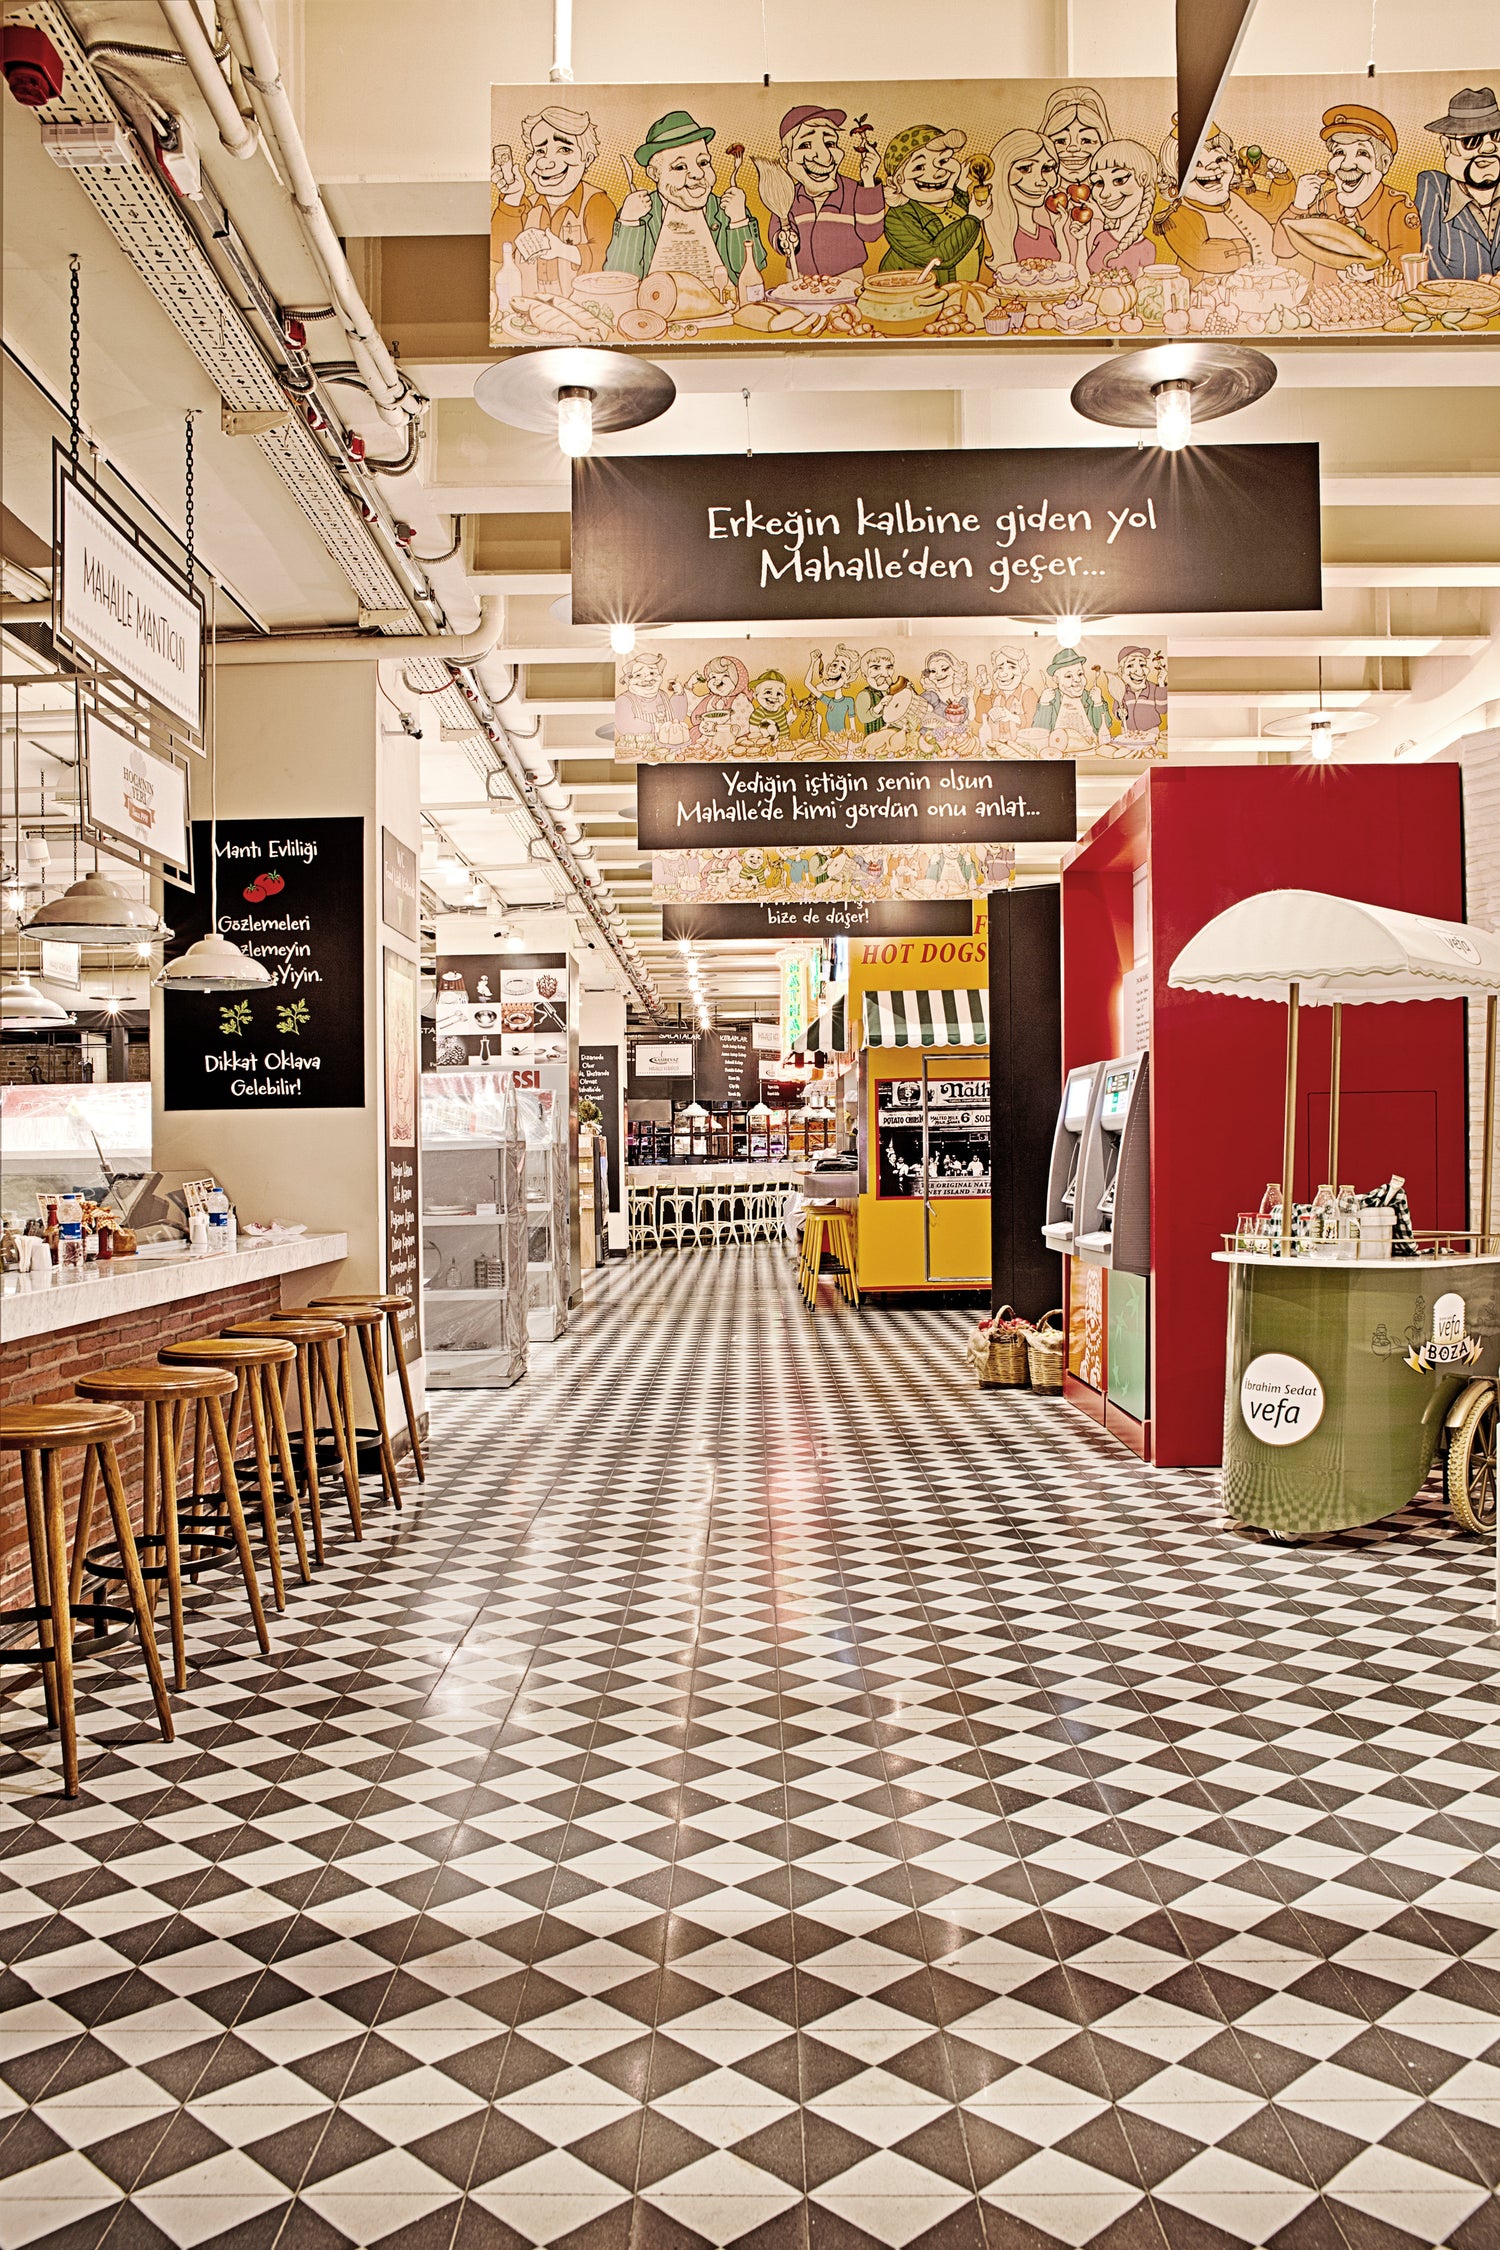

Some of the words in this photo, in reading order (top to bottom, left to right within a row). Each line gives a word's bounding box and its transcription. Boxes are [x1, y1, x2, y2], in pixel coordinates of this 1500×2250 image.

[708, 499, 840, 551] Erkeğin
[857, 497, 980, 535] kalbine
[995, 498, 1092, 547] giden
[1106, 497, 1157, 544] yol
[760, 545, 973, 588] Mahalle'den
[988, 553, 1106, 593] geçer...
[83, 546, 134, 628] MAHALLE
[722, 770, 797, 802] Yediğin
[805, 772, 868, 801] içtiğin
[876, 771, 931, 792] senin
[939, 768, 993, 789] olsun
[676, 798, 784, 827] Mahalle'de
[792, 796, 837, 822] kimi
[845, 796, 919, 829] gördün
[927, 801, 966, 818] onu
[975, 795, 1041, 818] anlat...
[214, 840, 262, 859] Mantı
[269, 839, 318, 864] Evliliği
[218, 914, 311, 932] Gözlemeleri
[768, 907, 798, 924] bize
[803, 907, 820, 924] de
[826, 907, 869, 929] düşer!
[240, 940, 311, 964] zlemeyin
[861, 943, 915, 965] HOT
[920, 942, 987, 963] DOGS
[277, 963, 323, 989] Yiyin.
[205, 1050, 258, 1073] Dikkat
[264, 1049, 321, 1071] Oklava
[230, 1077, 302, 1096] Gelebilir!
[961, 1112, 970, 1123] 6
[1439, 1314, 1461, 1340] vefa
[1428, 1341, 1468, 1361] BOZA
[1284, 1384, 1317, 1397] Sedat
[1250, 1398, 1301, 1429] vefa
